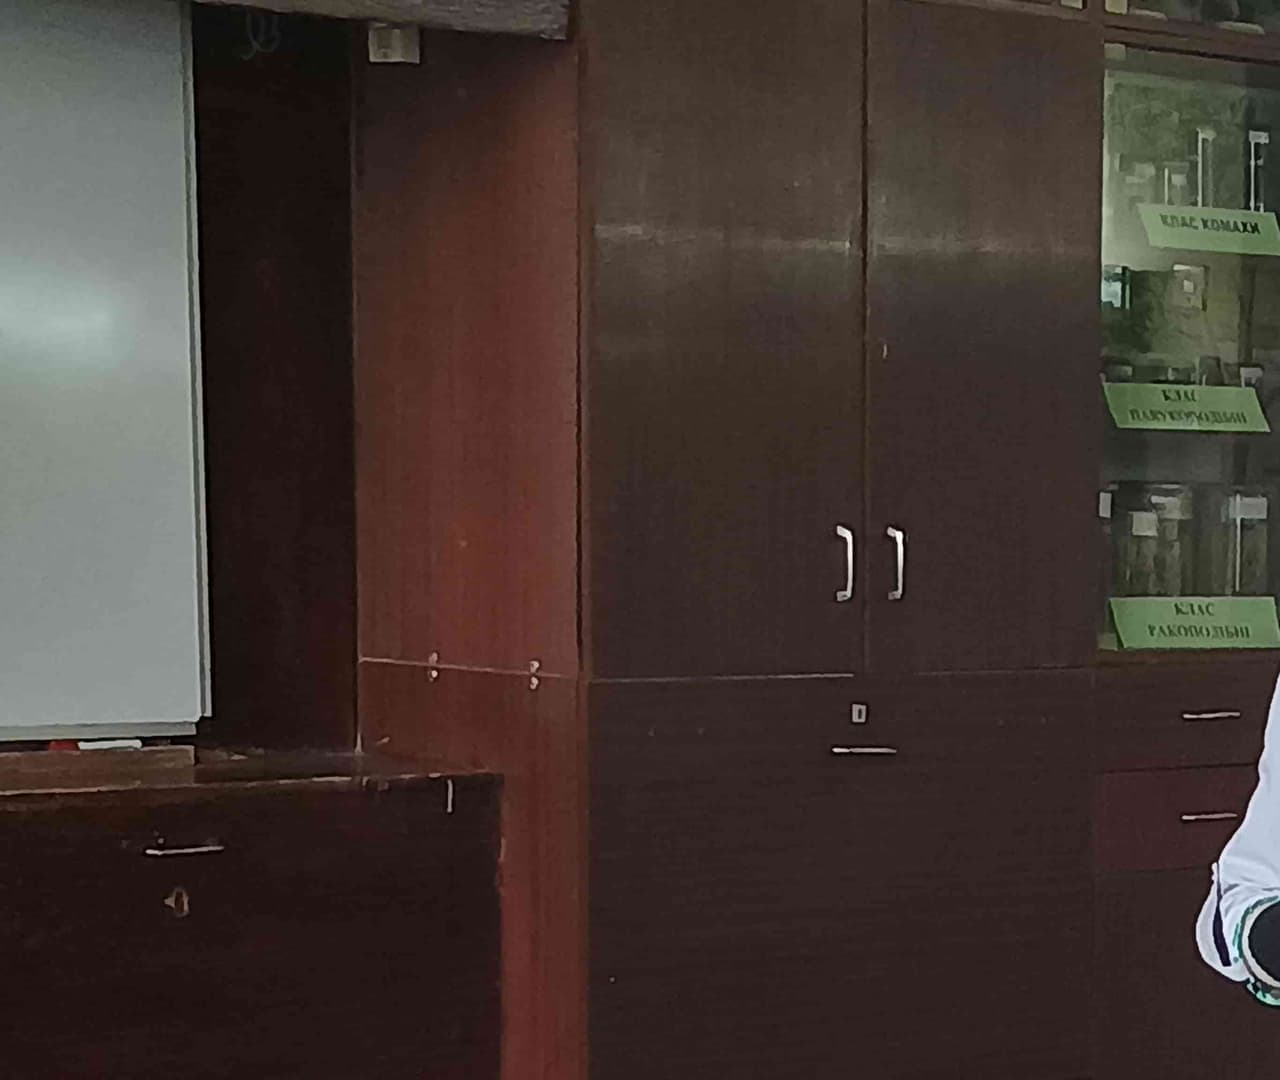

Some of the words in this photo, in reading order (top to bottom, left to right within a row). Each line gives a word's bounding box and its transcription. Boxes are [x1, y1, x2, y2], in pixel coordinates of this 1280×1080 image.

[1160, 213, 1199, 230] КЛАС
[1201, 217, 1261, 235] КОМАХИ
[1174, 602, 1216, 616] КЛАС
